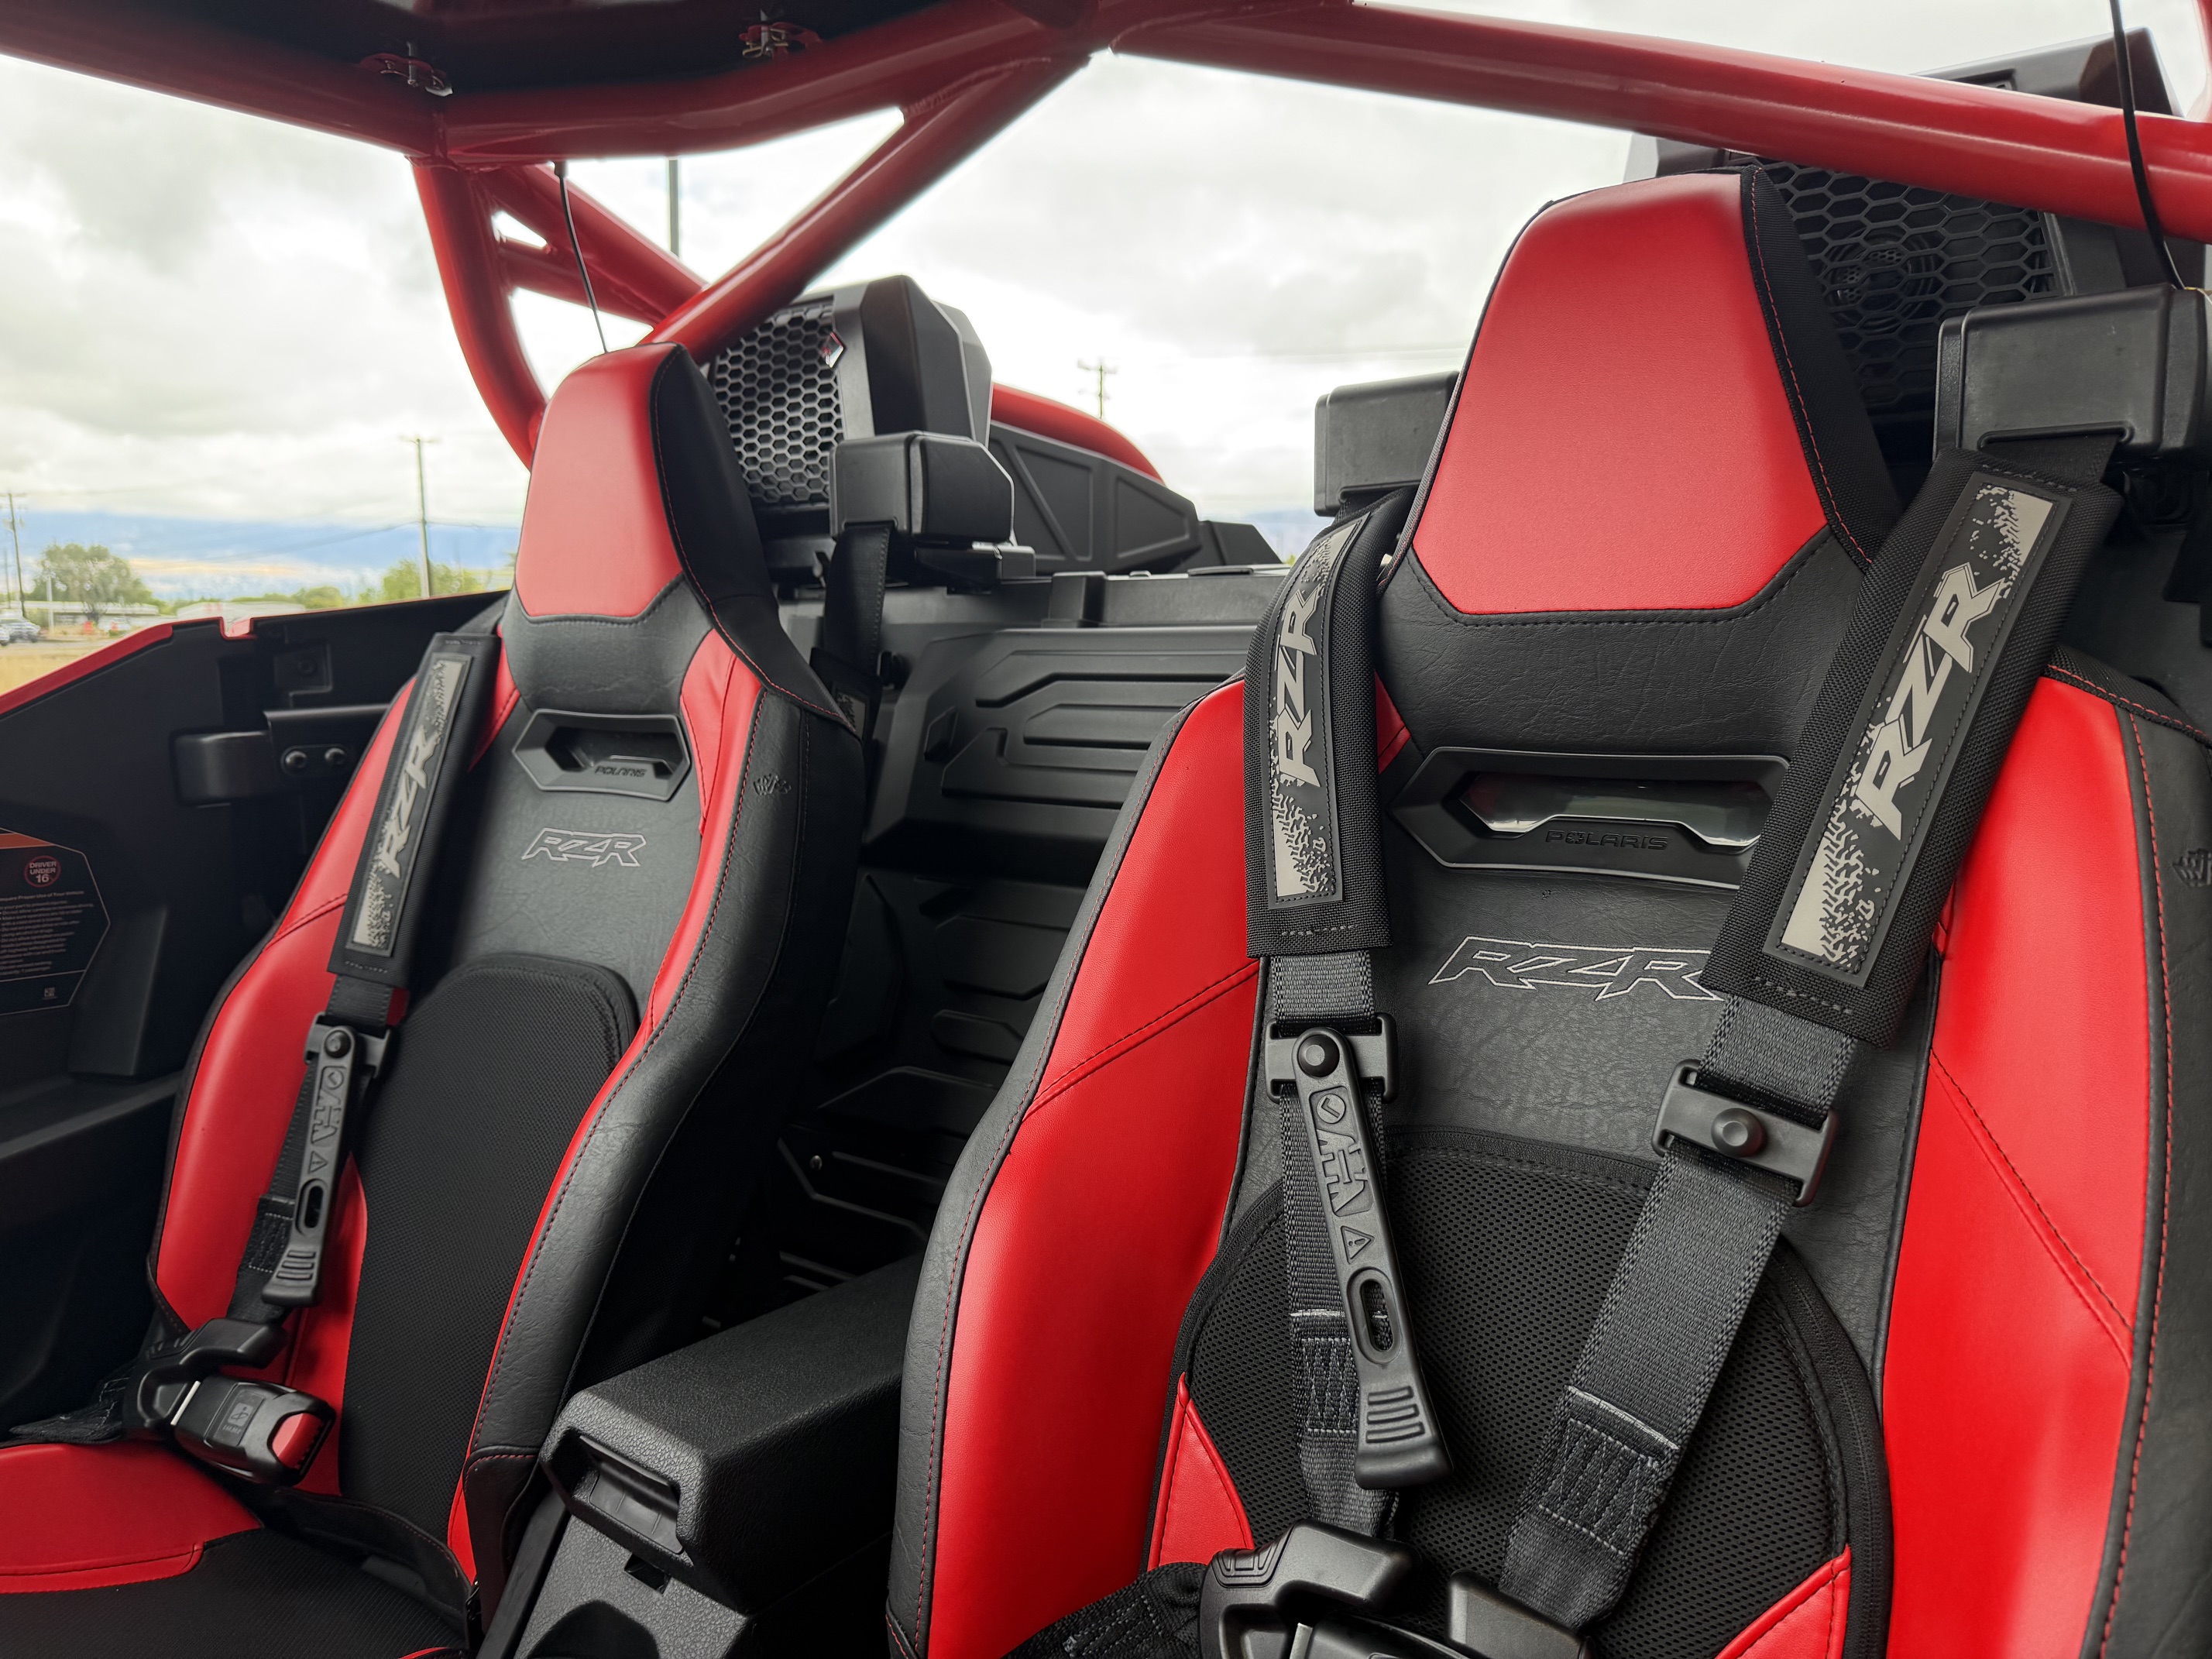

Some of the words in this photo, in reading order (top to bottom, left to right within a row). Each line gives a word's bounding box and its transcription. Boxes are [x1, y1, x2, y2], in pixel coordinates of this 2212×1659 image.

[1274, 588, 1321, 788] RZR
[1857, 562, 2006, 840] RZR
[595, 765, 647, 778] POLARIS
[380, 725, 441, 879] RZR
[521, 827, 647, 867] RZR
[1545, 829, 1671, 850] POLARIS
[29, 860, 57, 869] DRIVER
[35, 874, 50, 883] 16
[1427, 936, 1724, 1001] RZR
